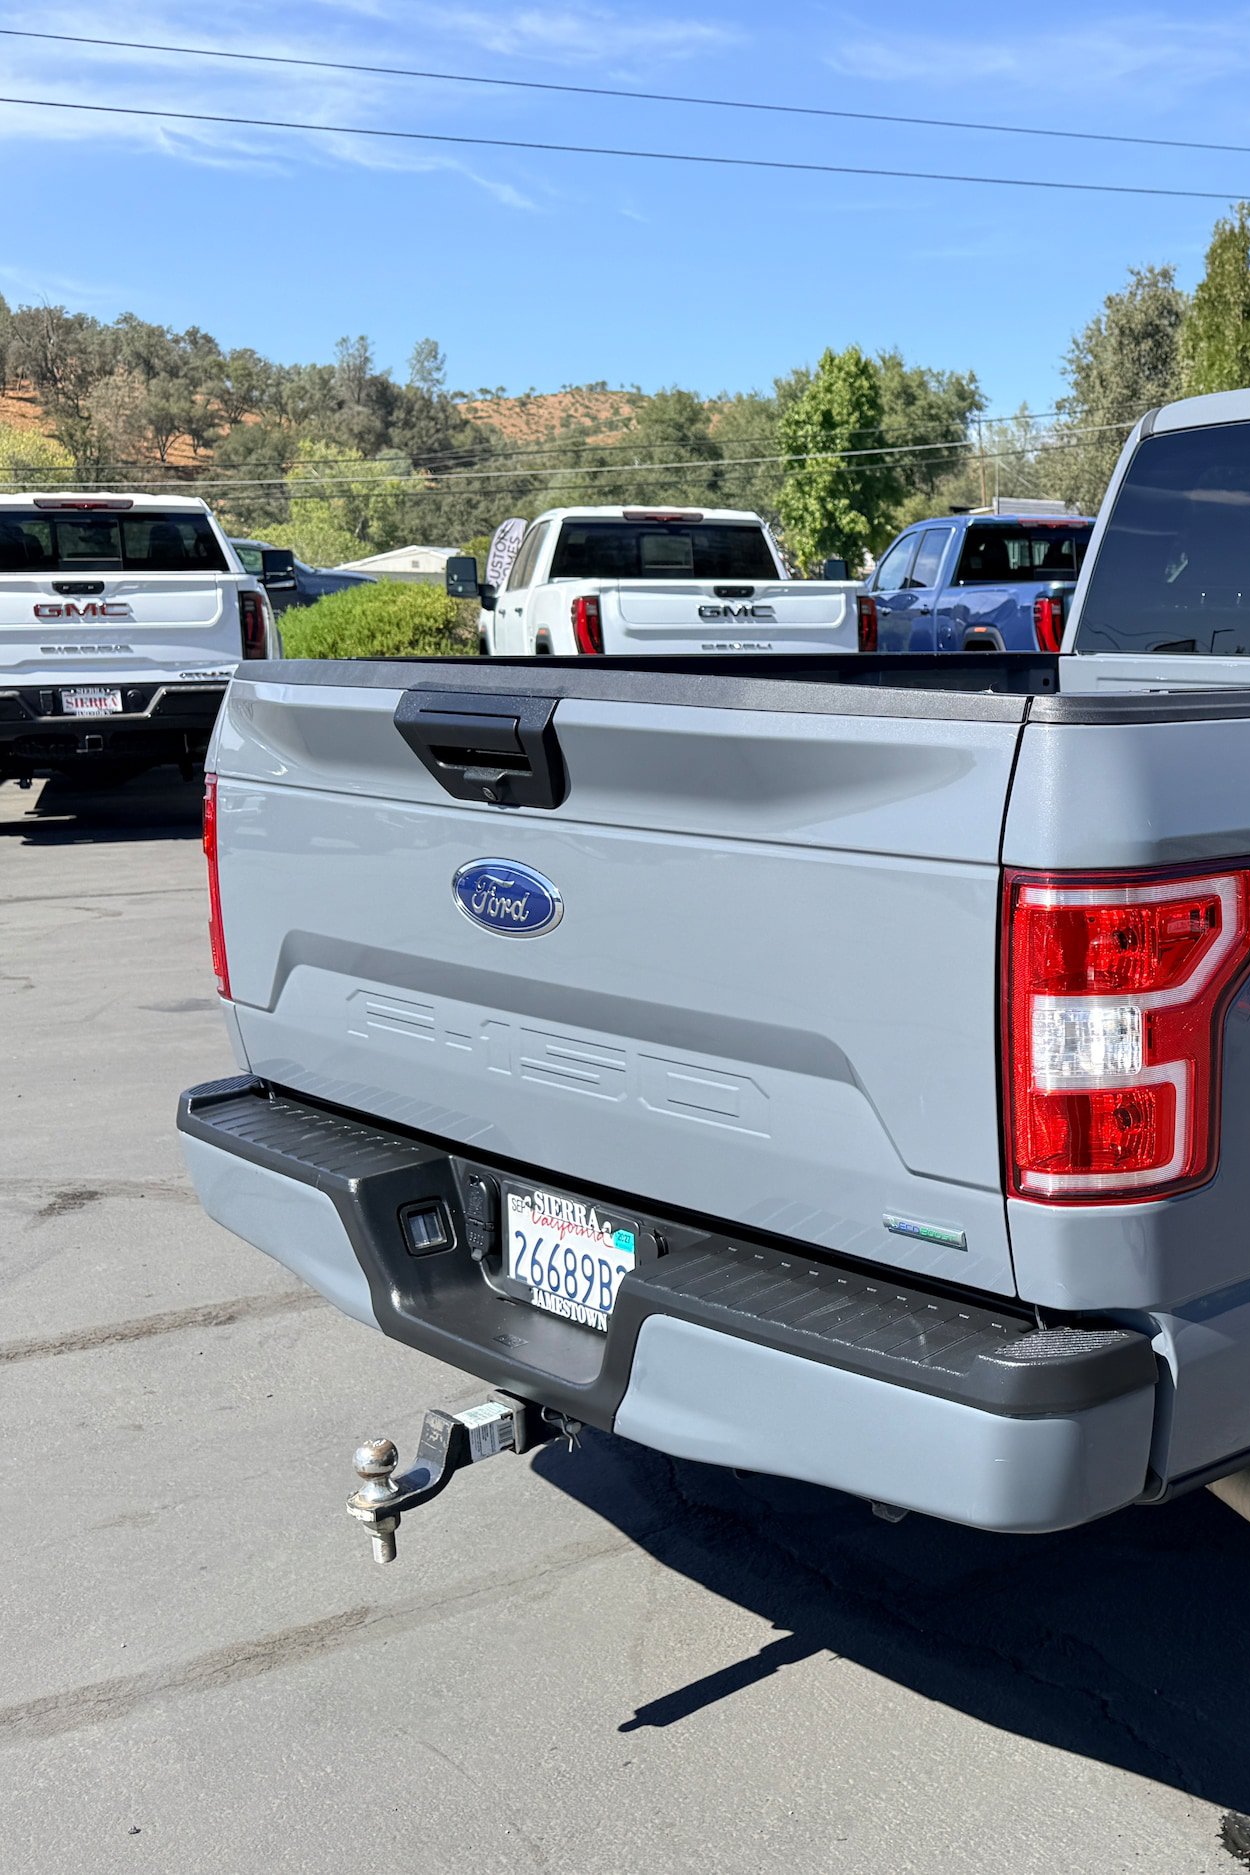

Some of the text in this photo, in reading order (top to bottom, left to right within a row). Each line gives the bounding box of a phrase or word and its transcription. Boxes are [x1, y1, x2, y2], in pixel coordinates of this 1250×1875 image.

[34, 603, 129, 618] GMC
[698, 605, 776, 618] GMC
[65, 697, 118, 709] SIERRA
[471, 874, 531, 922] Ford
[346, 989, 771, 1139] F-150
[533, 1190, 601, 1233] SIERRA
[531, 1286, 608, 1333] JAMESTOWN
